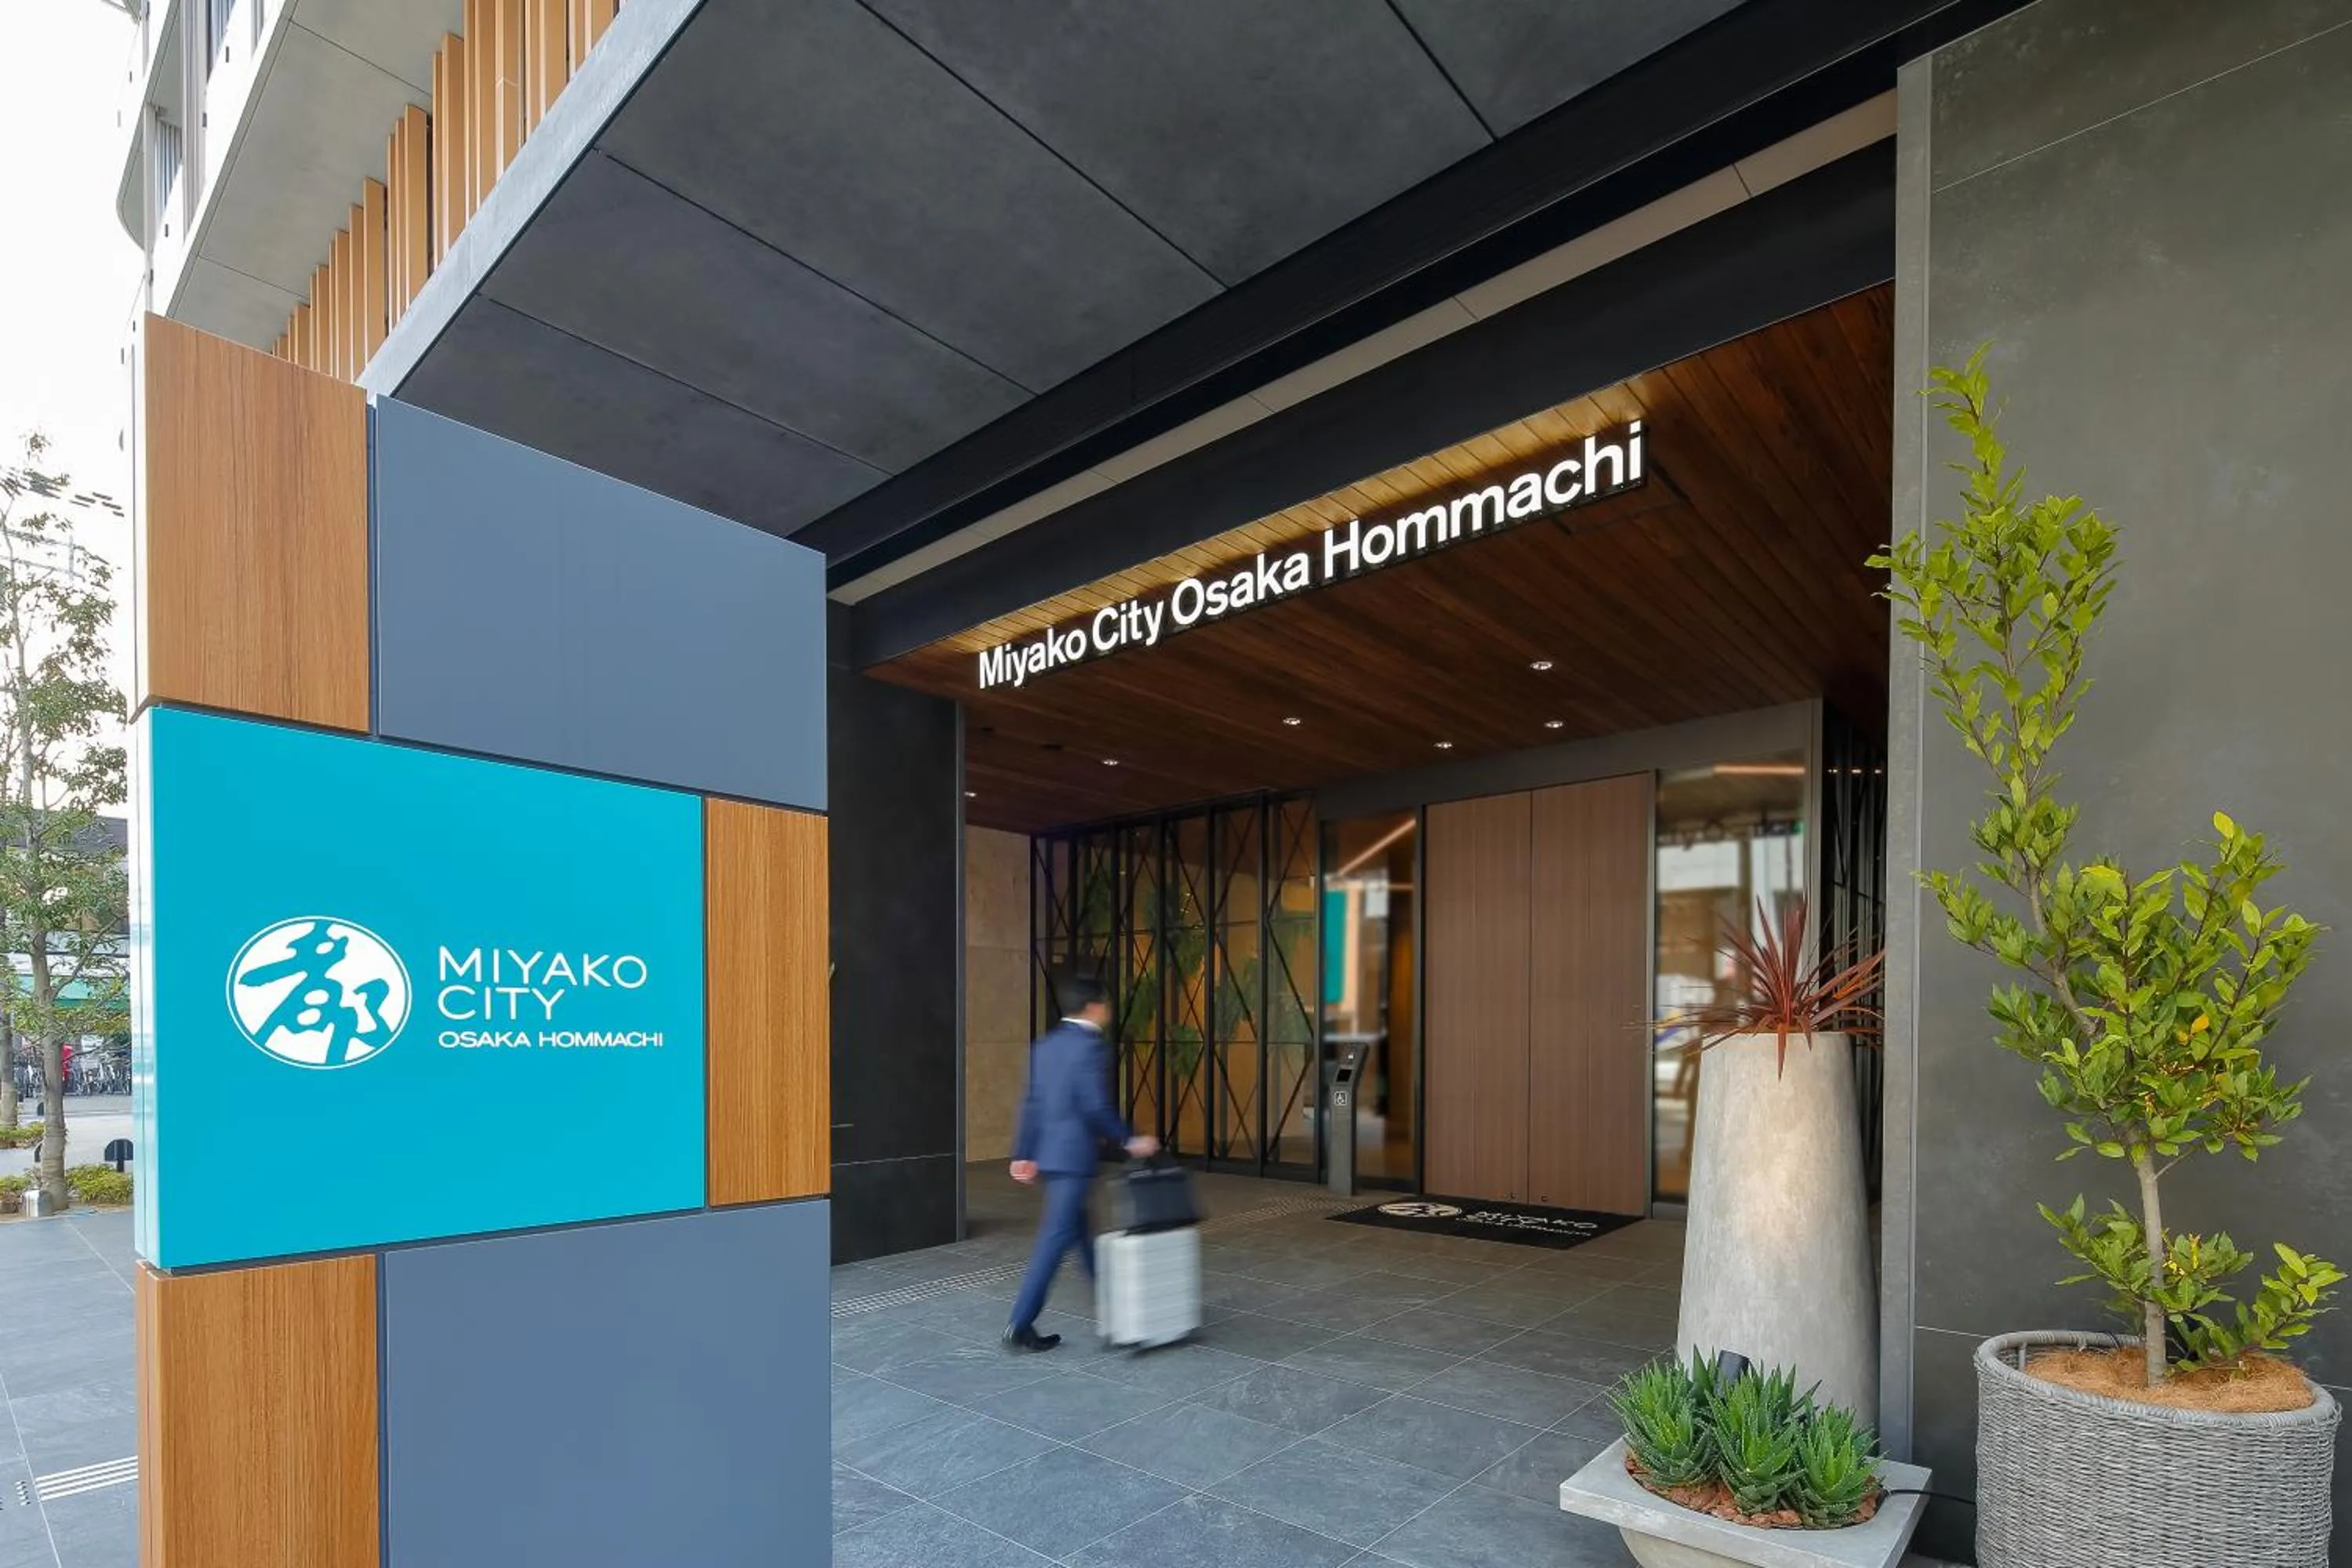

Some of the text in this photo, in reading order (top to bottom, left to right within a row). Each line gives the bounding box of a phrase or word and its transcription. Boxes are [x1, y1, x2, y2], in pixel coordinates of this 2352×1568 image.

[978, 419, 1642, 690] Miyako City Osaka Hommachi
[438, 945, 648, 989] MIYAKO
[437, 983, 566, 1021] CITY
[437, 1029, 664, 1049] OSAKA HOMMACHI
